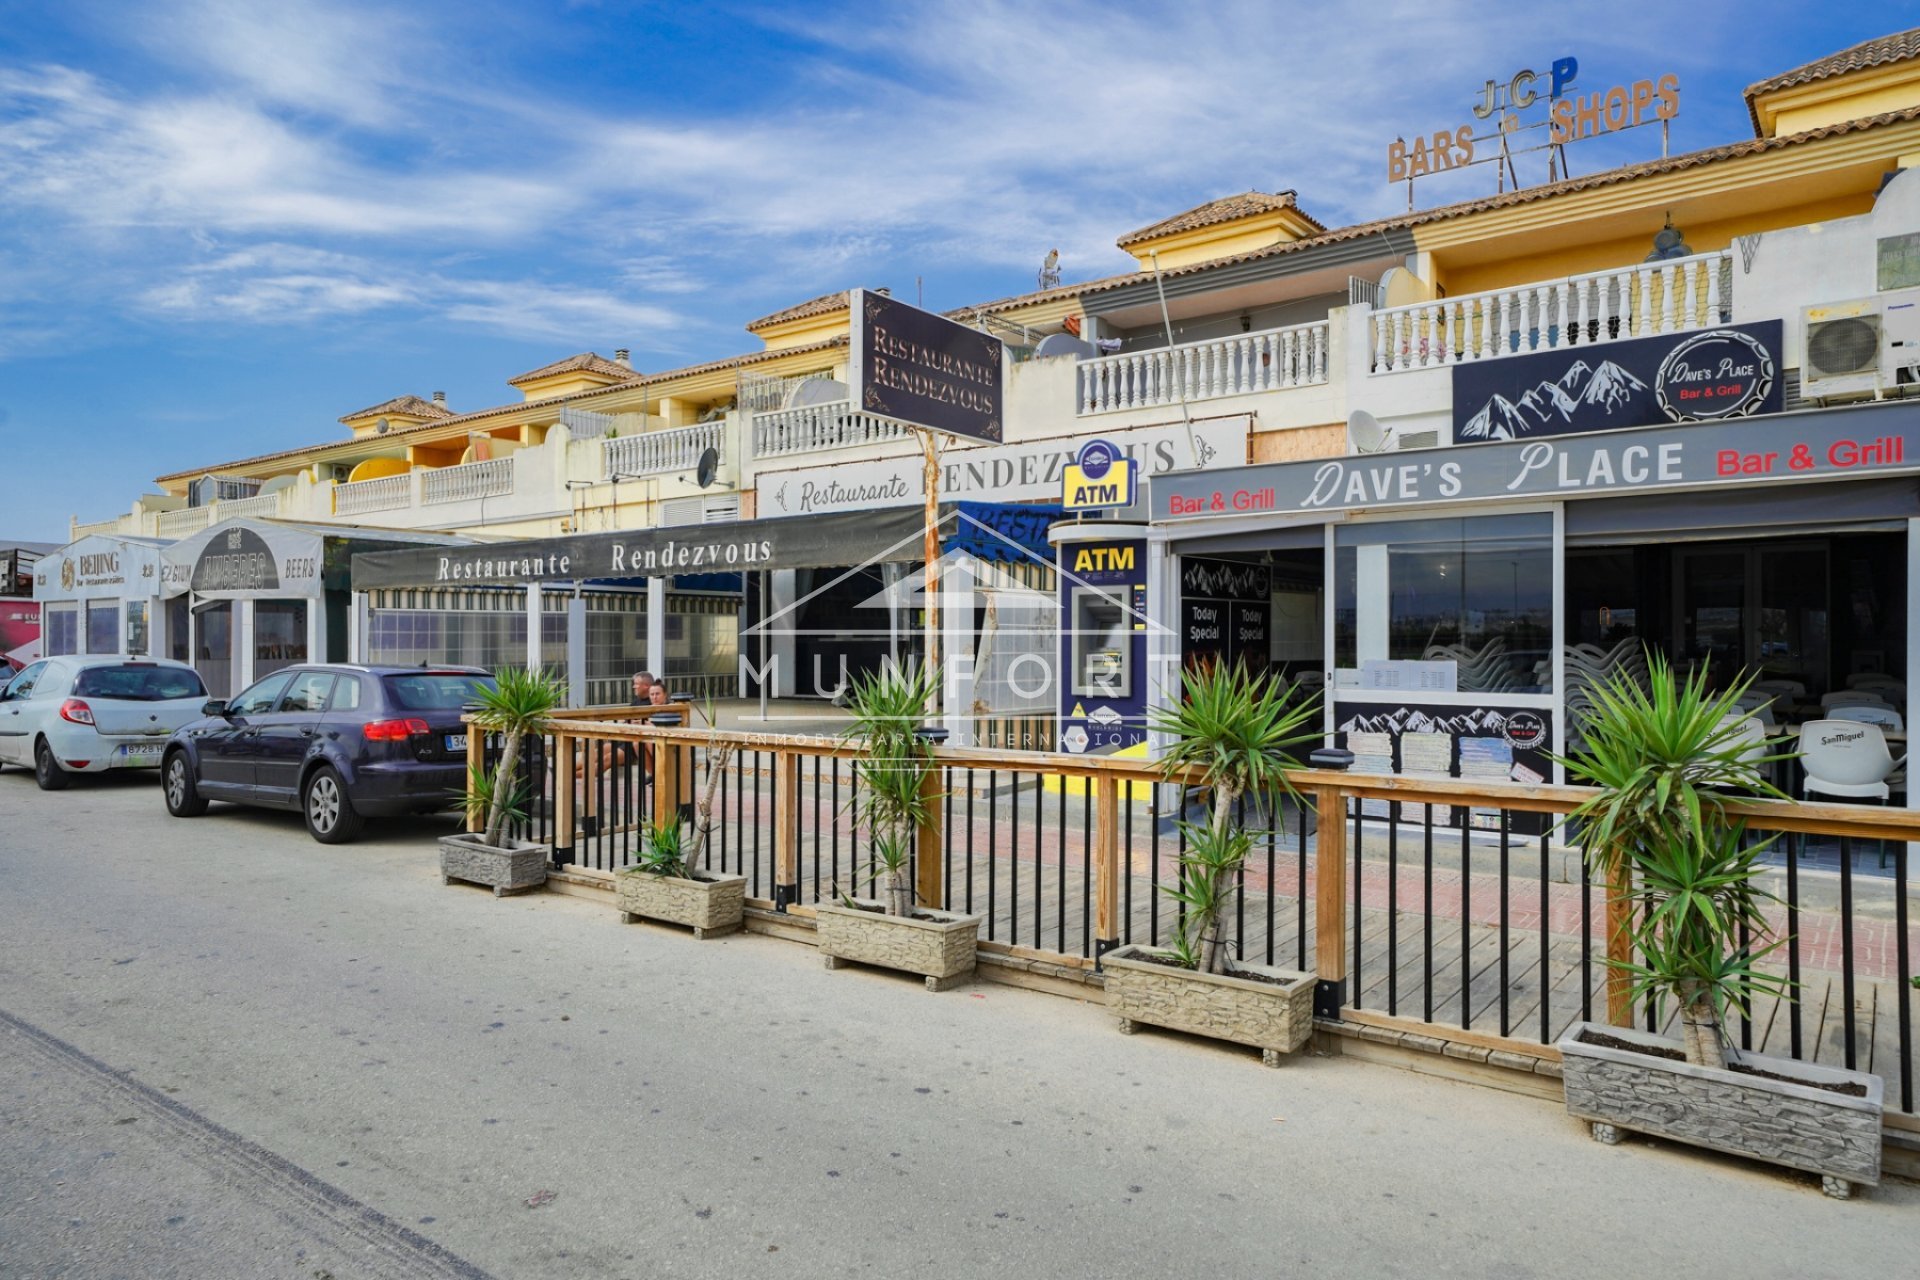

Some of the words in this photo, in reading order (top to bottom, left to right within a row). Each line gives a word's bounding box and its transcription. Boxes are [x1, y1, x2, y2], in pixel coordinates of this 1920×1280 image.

[1551, 73, 1680, 145] SHOPS
[1388, 124, 1474, 184] BARS
[873, 325, 993, 387] RESTAURANTE
[1715, 357, 1755, 379] PLACE
[873, 356, 993, 415] RENDEZVOUS
[1680, 389, 1701, 400] Bar
[1704, 387, 1713, 397] &
[1717, 384, 1742, 396] Grill
[1169, 494, 1201, 514] Bar
[1211, 492, 1225, 511] &
[1232, 488, 1275, 510] Grill
[1301, 461, 1461, 507] DAVE'S
[1507, 442, 1684, 491] PLACE
[1716, 449, 1777, 476] Bar
[1788, 443, 1815, 469] &
[1828, 436, 1904, 467] Grill
[800, 474, 910, 512] Restaurante
[1073, 484, 1118, 504] ATM
[80, 552, 119, 576] BEIJING
[285, 557, 315, 579] BEERS
[437, 553, 571, 581] Restaurante
[611, 540, 771, 572] Rendezvous
[1074, 547, 1135, 572] ATM
[1192, 606, 1218, 623] Today
[1241, 608, 1263, 624] Today
[1190, 626, 1220, 643] Special
[1239, 627, 1264, 643] Special
